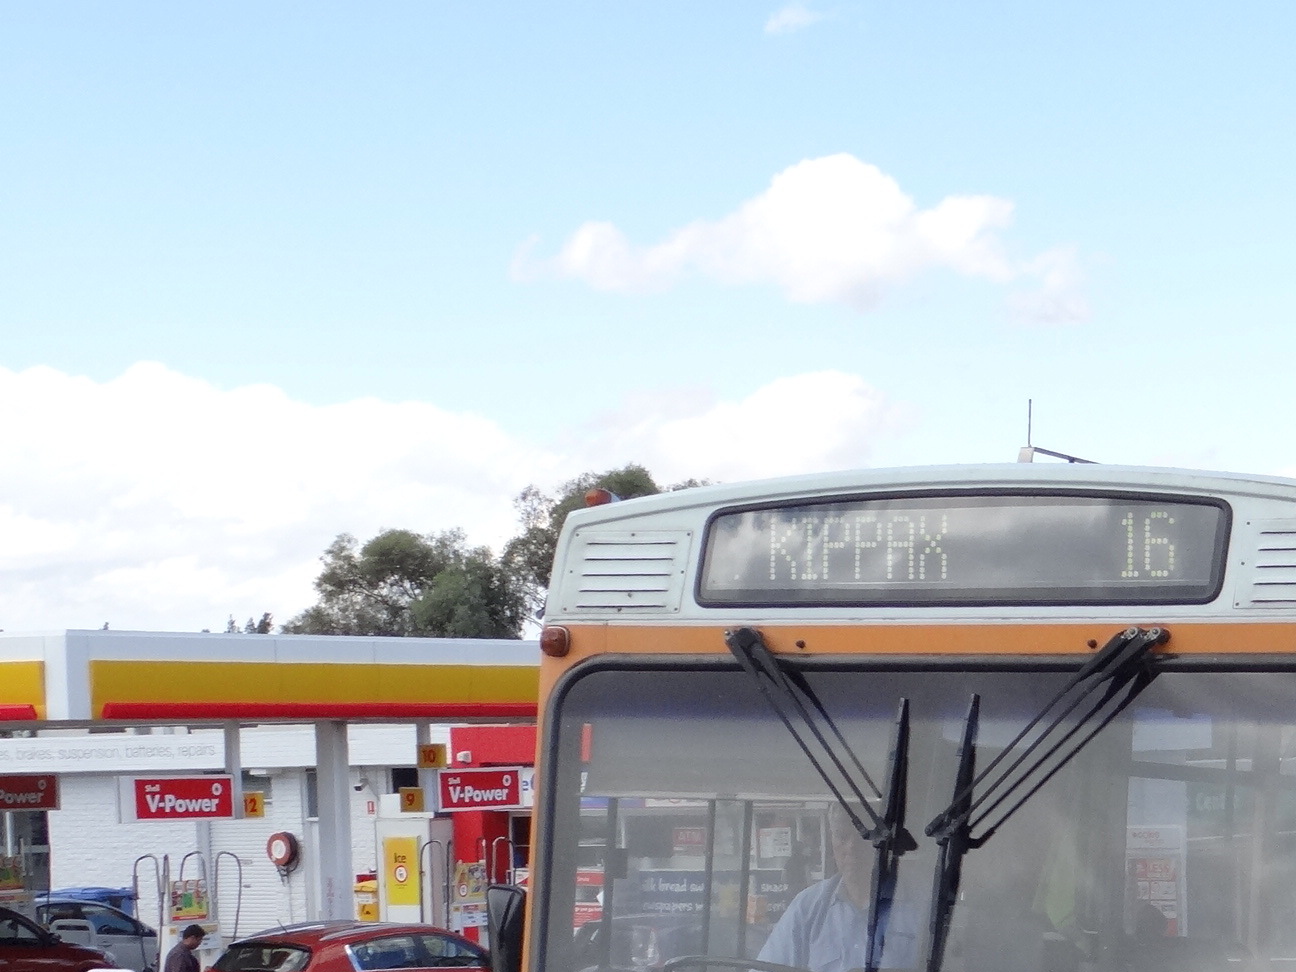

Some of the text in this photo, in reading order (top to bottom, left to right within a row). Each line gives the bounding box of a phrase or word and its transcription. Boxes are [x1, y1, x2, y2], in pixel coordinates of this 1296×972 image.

[769, 511, 1176, 580] KIPPAX 16
[422, 749, 437, 763] 10
[405, 793, 415, 806] 9
[448, 786, 509, 803] V-Power
[145, 794, 220, 813] V-Power
[394, 852, 407, 863] Ice
